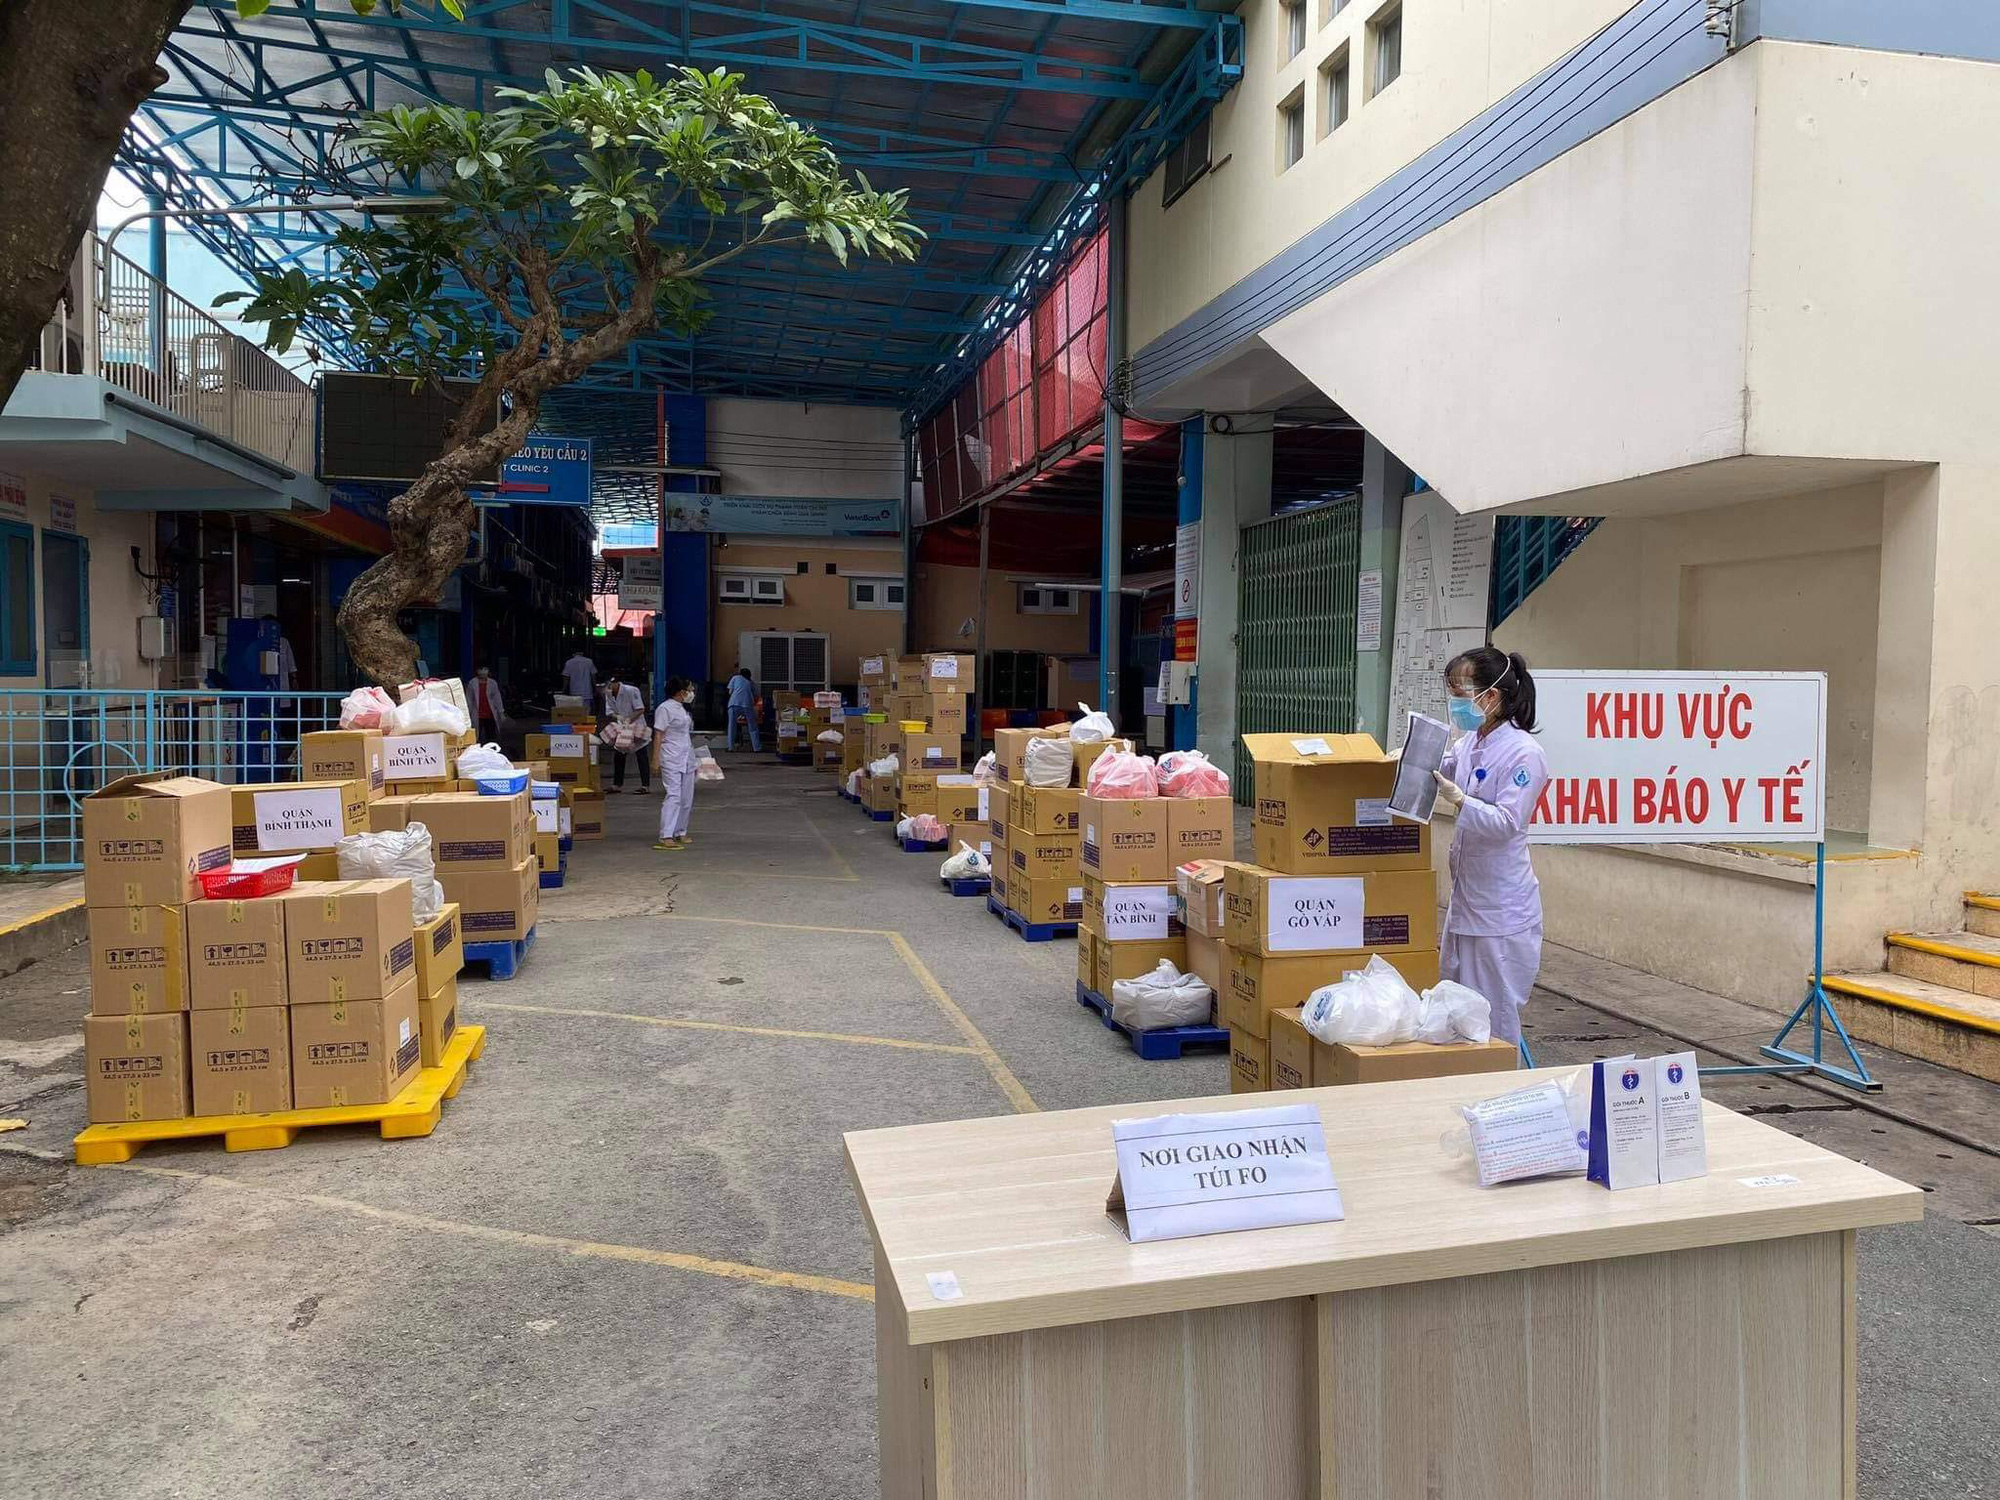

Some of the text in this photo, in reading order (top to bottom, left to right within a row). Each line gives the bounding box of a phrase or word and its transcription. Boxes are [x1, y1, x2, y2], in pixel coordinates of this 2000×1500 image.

[556, 442, 578, 460] CẦU
[580, 450, 587, 460] 2
[510, 464, 541, 472] CLINIC
[1586, 684, 1753, 749] KHU VỰC
[389, 756, 414, 766] BÌNH
[1530, 759, 1811, 824] KHAI BÁO Y TẾ
[282, 808, 313, 819] QUẬN
[265, 819, 332, 831] BÌNH THẠNH
[1294, 898, 1336, 912] QUẬN
[1130, 912, 1156, 923] BÌNH
[1288, 912, 1341, 928] GÒ VẤP
[1638, 1096, 1645, 1104] A
[1139, 1134, 1308, 1168] NƠI GIAO NHẬN
[1193, 1166, 1232, 1189] TÚI
